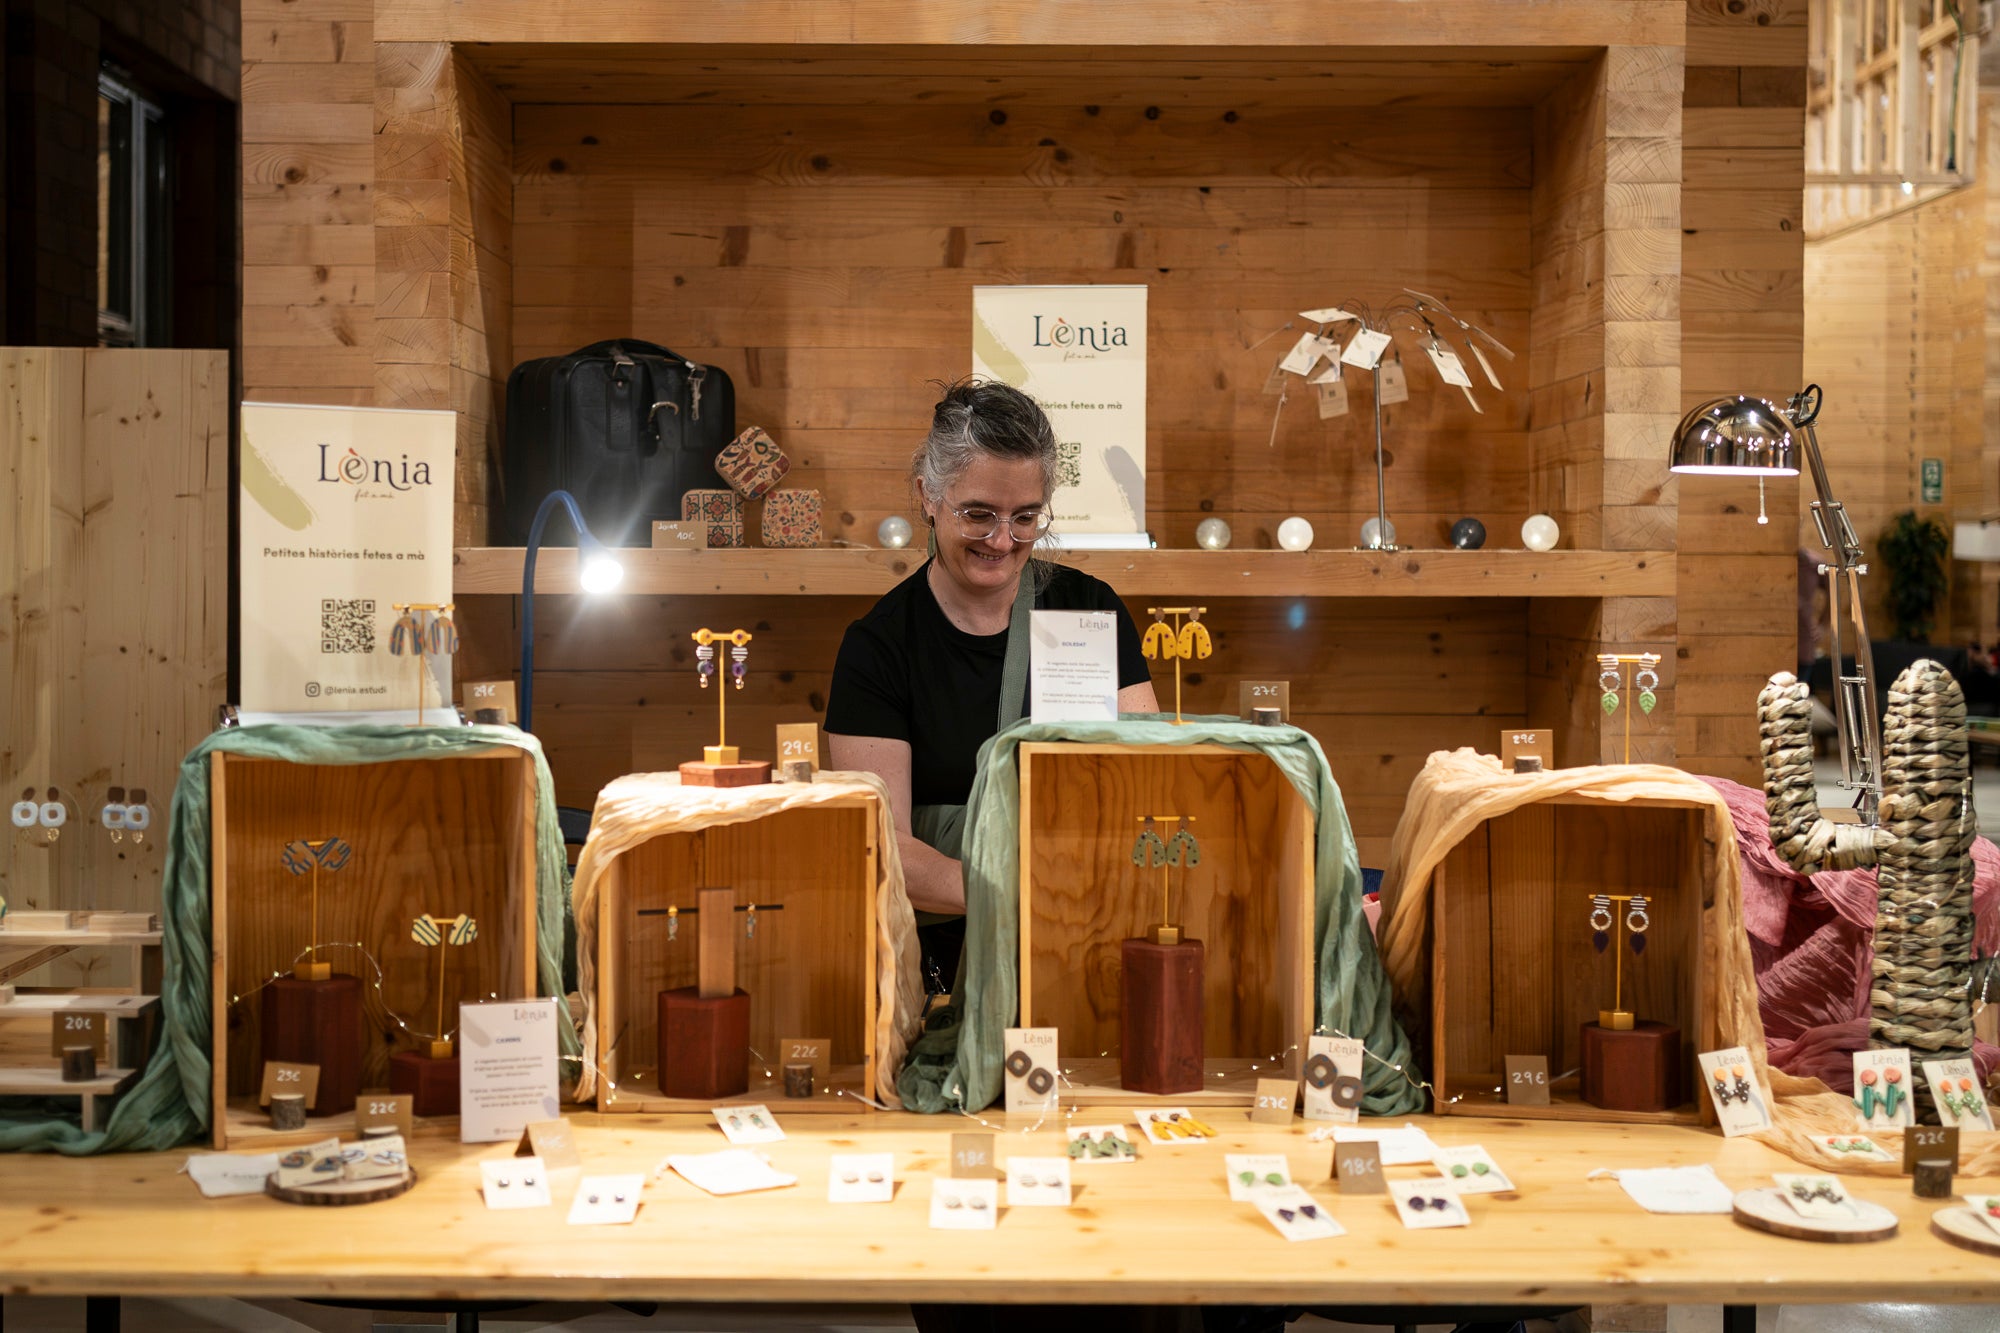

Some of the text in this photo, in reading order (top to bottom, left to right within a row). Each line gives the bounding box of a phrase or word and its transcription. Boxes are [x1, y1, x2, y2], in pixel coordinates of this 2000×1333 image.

[1033, 315, 1128, 352] Lènia
[1071, 401, 1095, 409] fetes
[1107, 401, 1122, 409] mà
[318, 443, 432, 491] Lènia
[263, 547, 305, 558] Petites
[308, 548, 360, 559] històries
[362, 549, 393, 560] fetes
[406, 550, 425, 561] mà
[473, 684, 496, 698] 29€
[1252, 685, 1278, 696] 27€
[782, 740, 814, 756] 29€
[64, 1016, 92, 1030] 20€
[791, 1045, 818, 1058] 22€
[276, 1070, 301, 1082] 25€
[1512, 1071, 1545, 1085] 29€
[369, 1102, 397, 1115] 22€
[1914, 1132, 1945, 1145] 22€
[956, 1150, 986, 1167] 18€
[1343, 1157, 1377, 1175] 18€
